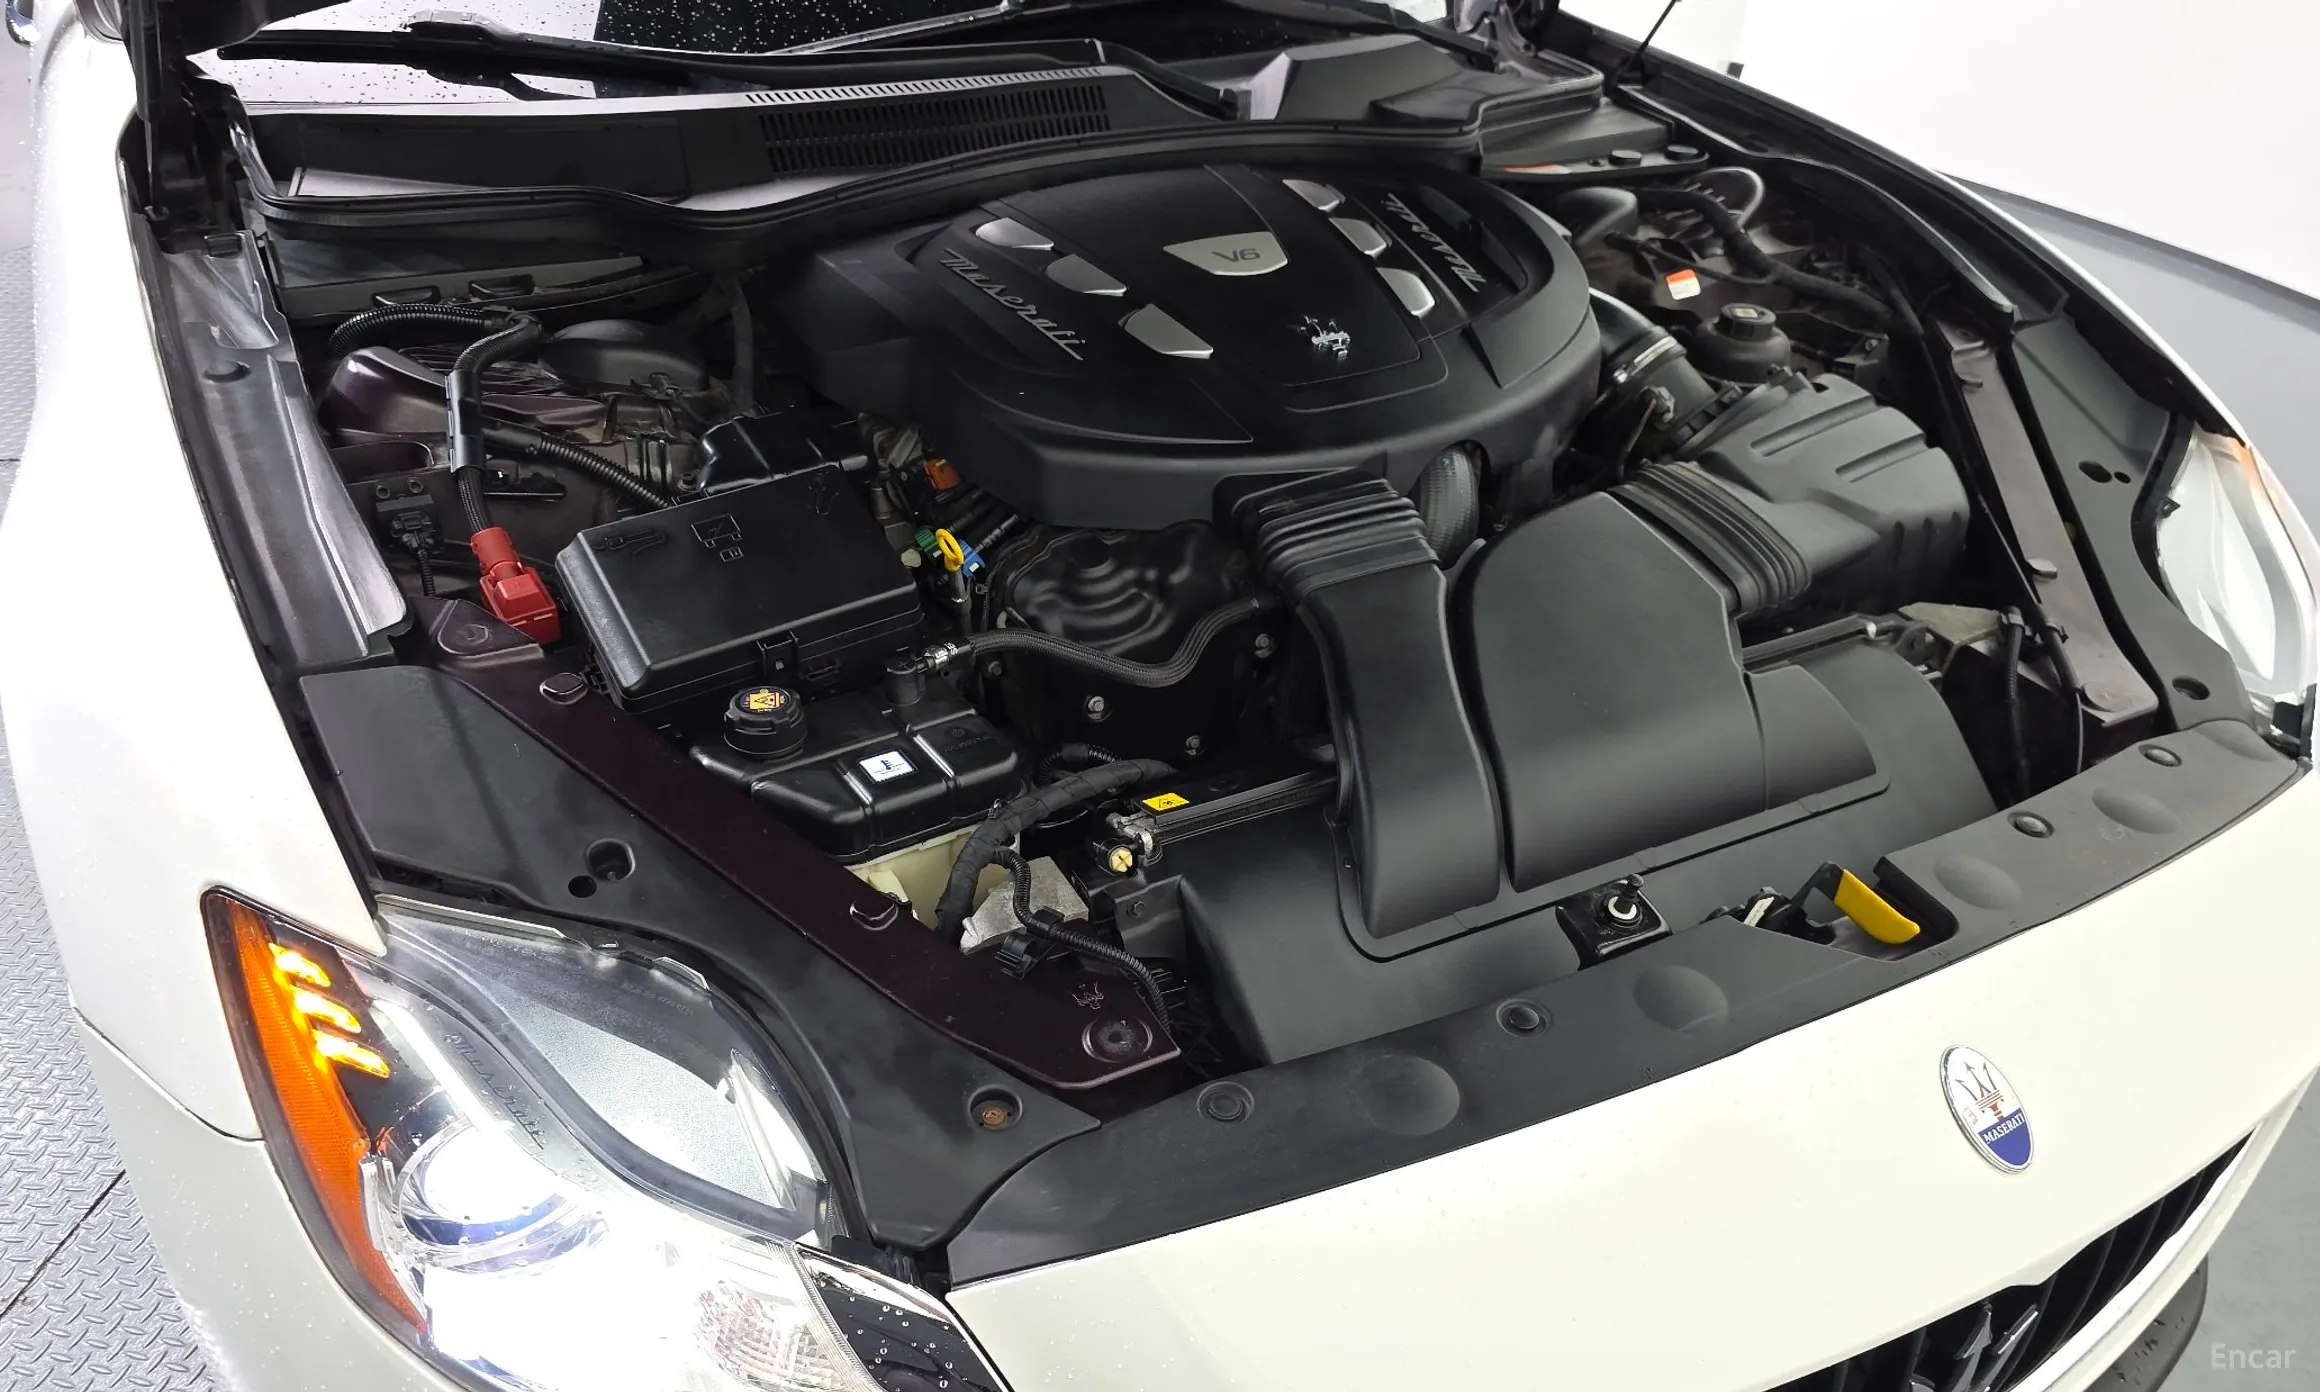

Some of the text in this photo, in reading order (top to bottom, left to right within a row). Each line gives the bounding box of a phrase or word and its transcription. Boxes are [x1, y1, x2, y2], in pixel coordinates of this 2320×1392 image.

[1211, 248, 1261, 262] V6
[1381, 193, 1487, 292] Maserati
[939, 248, 1086, 361] Maserati
[1982, 1113, 2025, 1144] MASERATI
